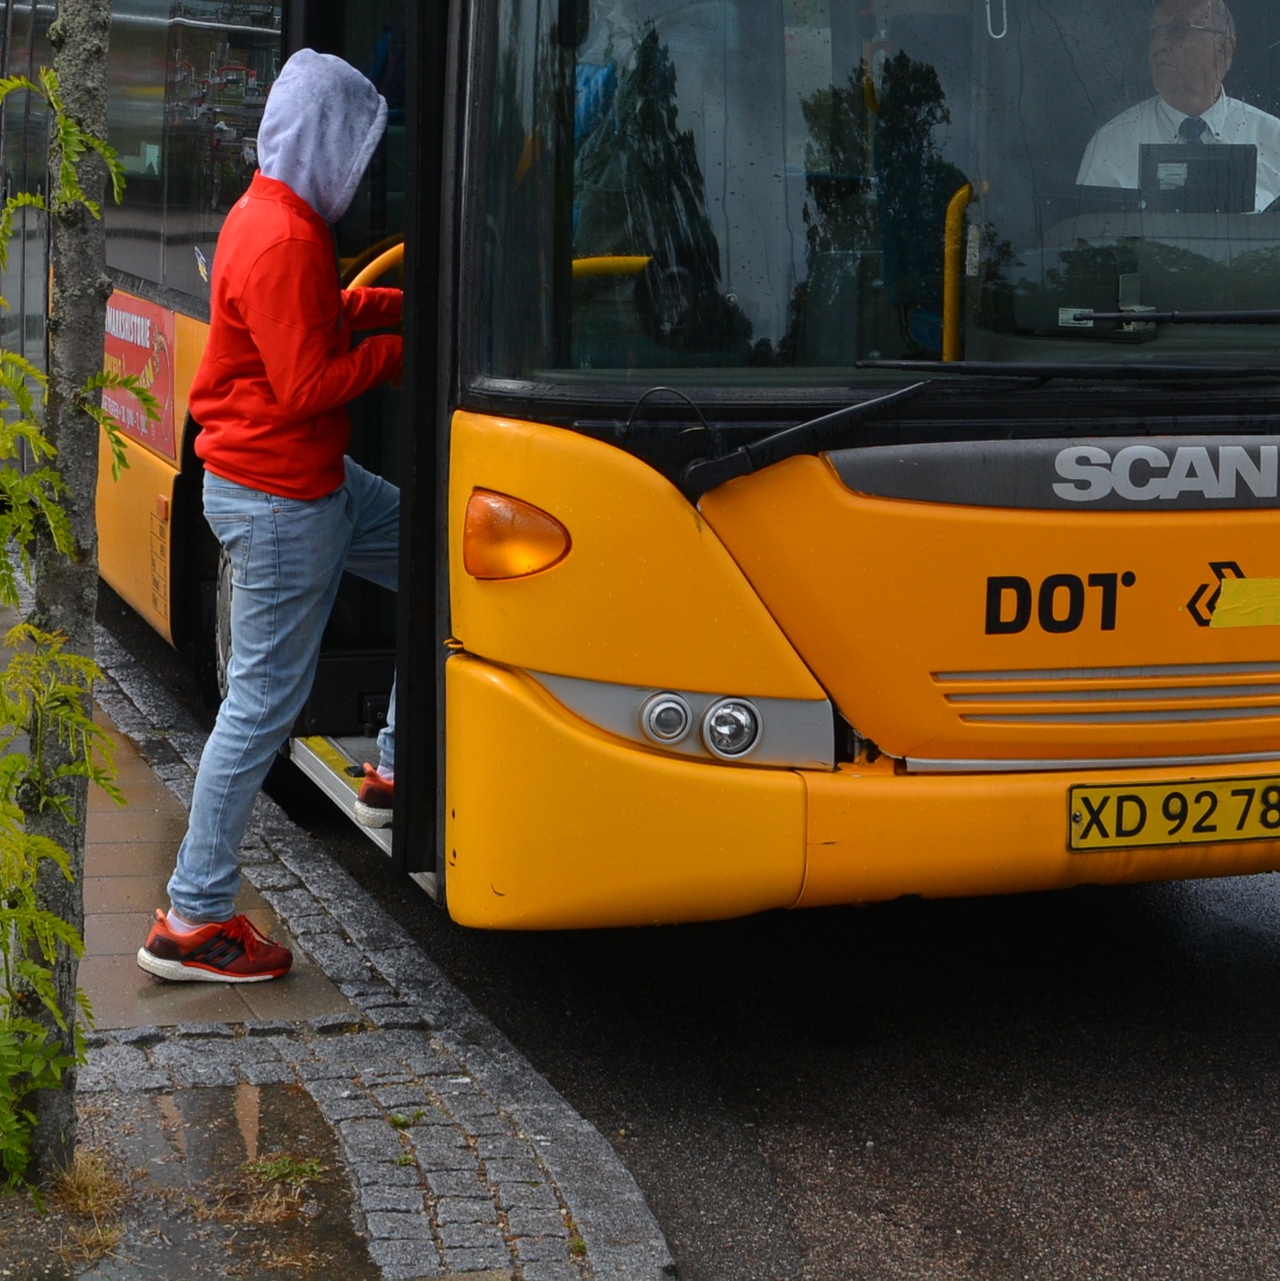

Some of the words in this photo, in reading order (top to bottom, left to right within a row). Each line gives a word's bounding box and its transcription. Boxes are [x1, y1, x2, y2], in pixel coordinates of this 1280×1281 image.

[984, 571, 1137, 636] DOT
[1079, 794, 1148, 840] XD
[1161, 790, 1218, 836] 92
